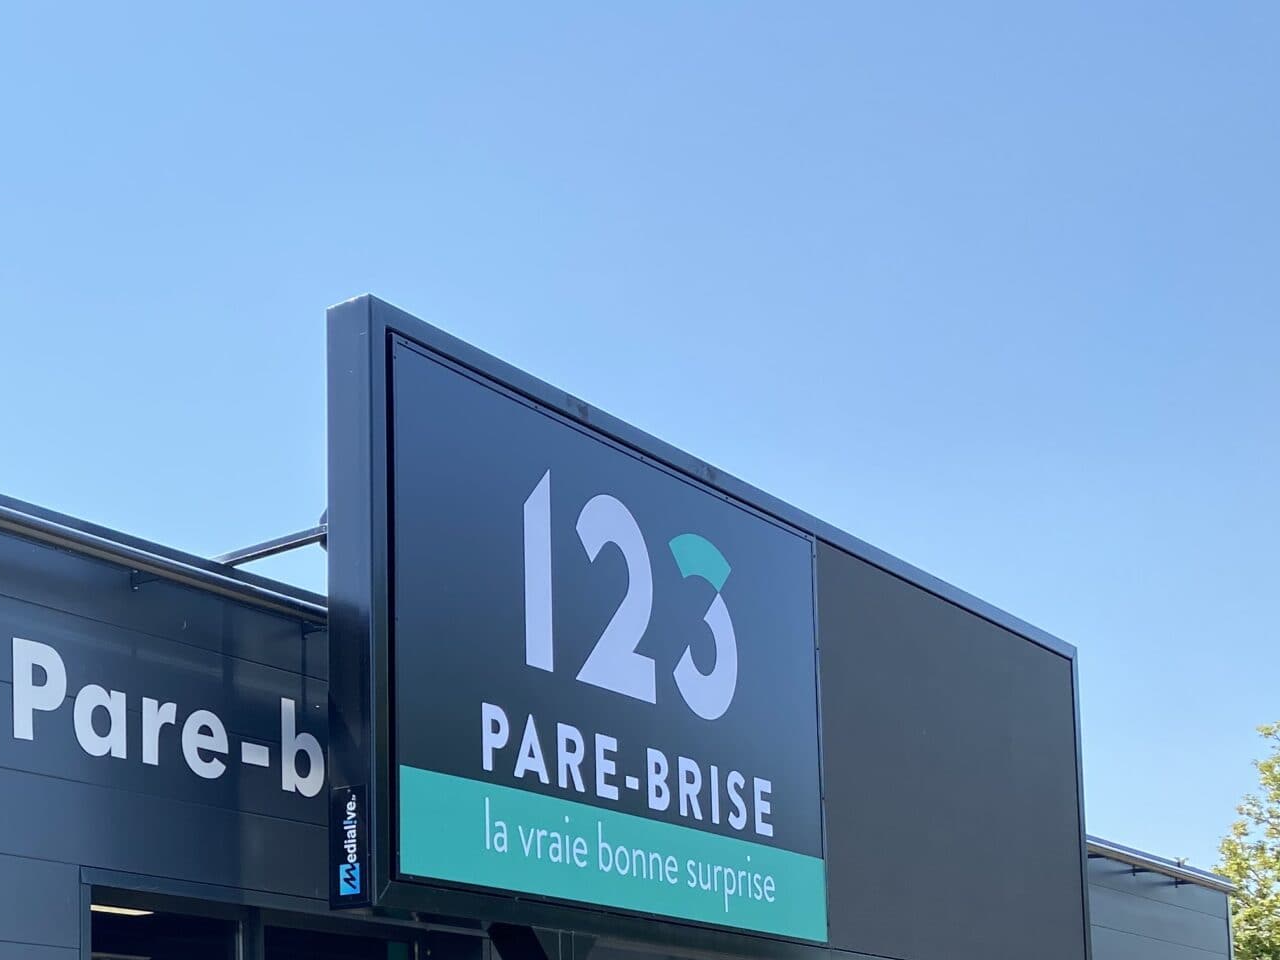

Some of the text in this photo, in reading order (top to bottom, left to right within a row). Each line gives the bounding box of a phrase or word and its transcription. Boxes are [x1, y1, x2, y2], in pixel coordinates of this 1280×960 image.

[523, 469, 738, 720] 123
[481, 701, 774, 838] PARE-BRISE
[484, 797, 776, 912] la vraie bonne surprise
